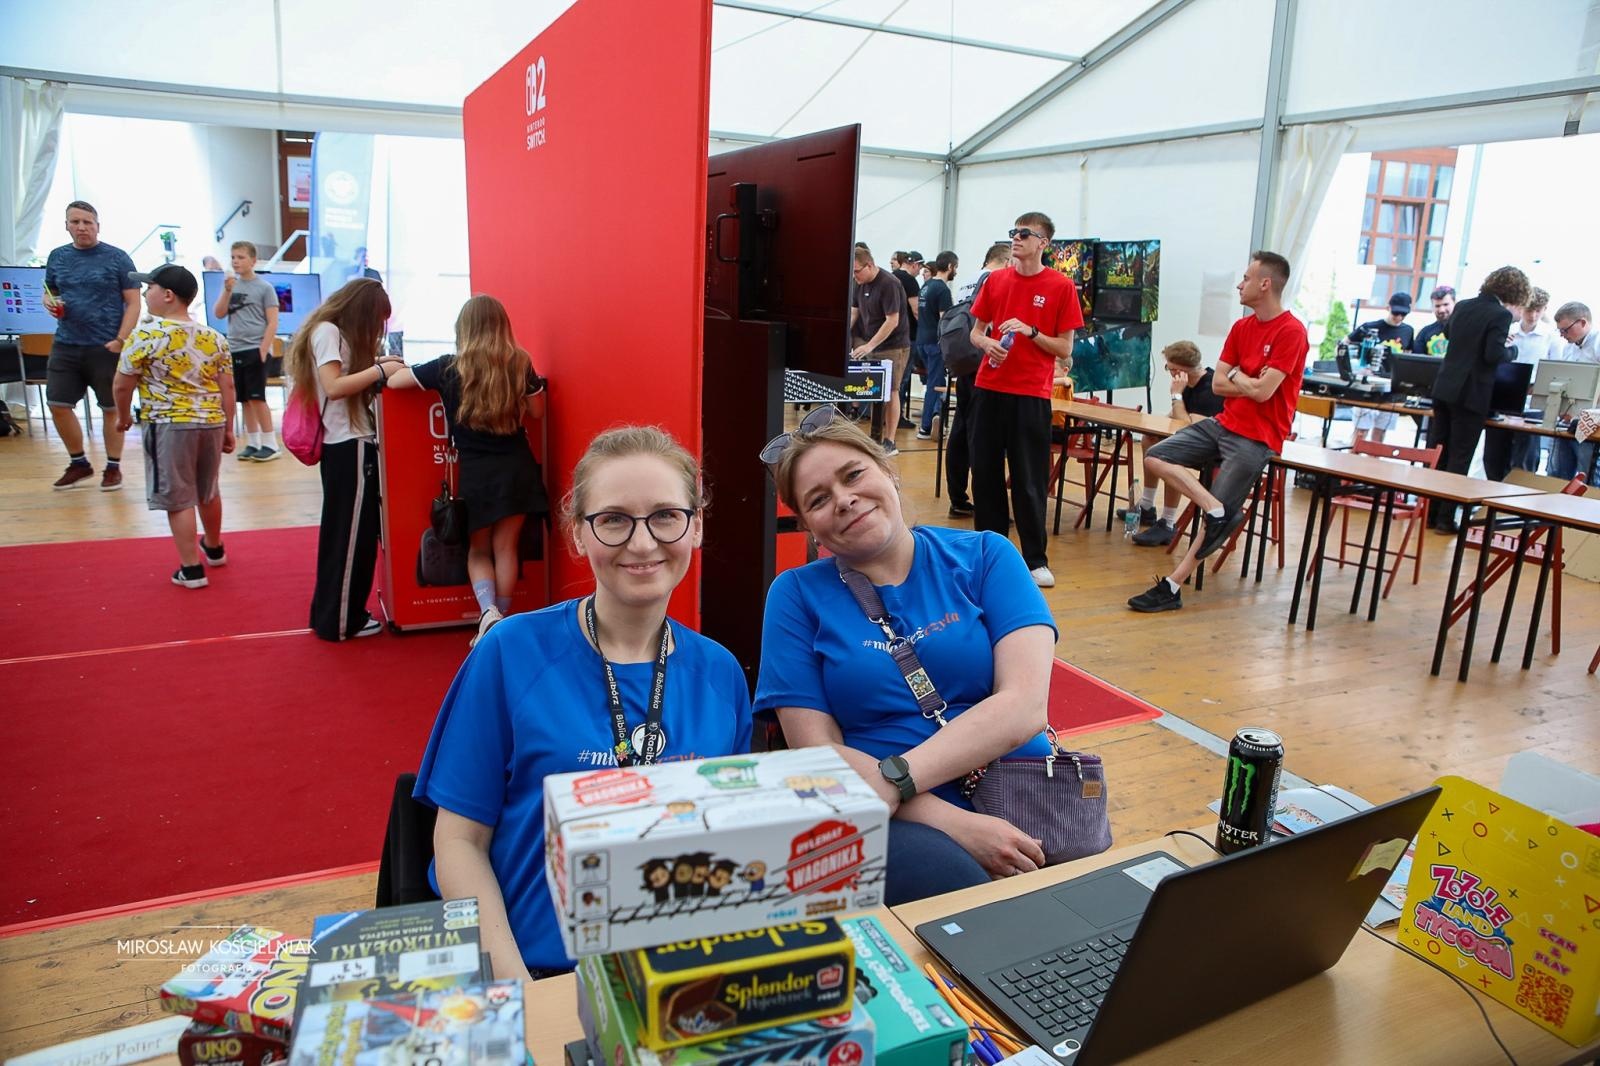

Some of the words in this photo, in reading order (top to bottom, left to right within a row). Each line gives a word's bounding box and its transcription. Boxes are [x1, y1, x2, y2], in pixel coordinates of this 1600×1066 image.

[526, 128, 547, 151] SWITCH
[652, 671, 665, 710] Biblioteka
[615, 713, 626, 742] Biblio
[1219, 819, 1259, 841] NSTER
[1220, 832, 1248, 846] ERGY
[792, 843, 859, 890] WAGONIKA
[1441, 898, 1494, 937] LAND
[1414, 904, 1515, 981] TYCOON
[1538, 926, 1578, 955] SCAN
[1534, 951, 1572, 976] PLAY
[249, 939, 311, 1019] UNO
[724, 970, 815, 1010] Splendor
[193, 1037, 243, 1060] UNO
